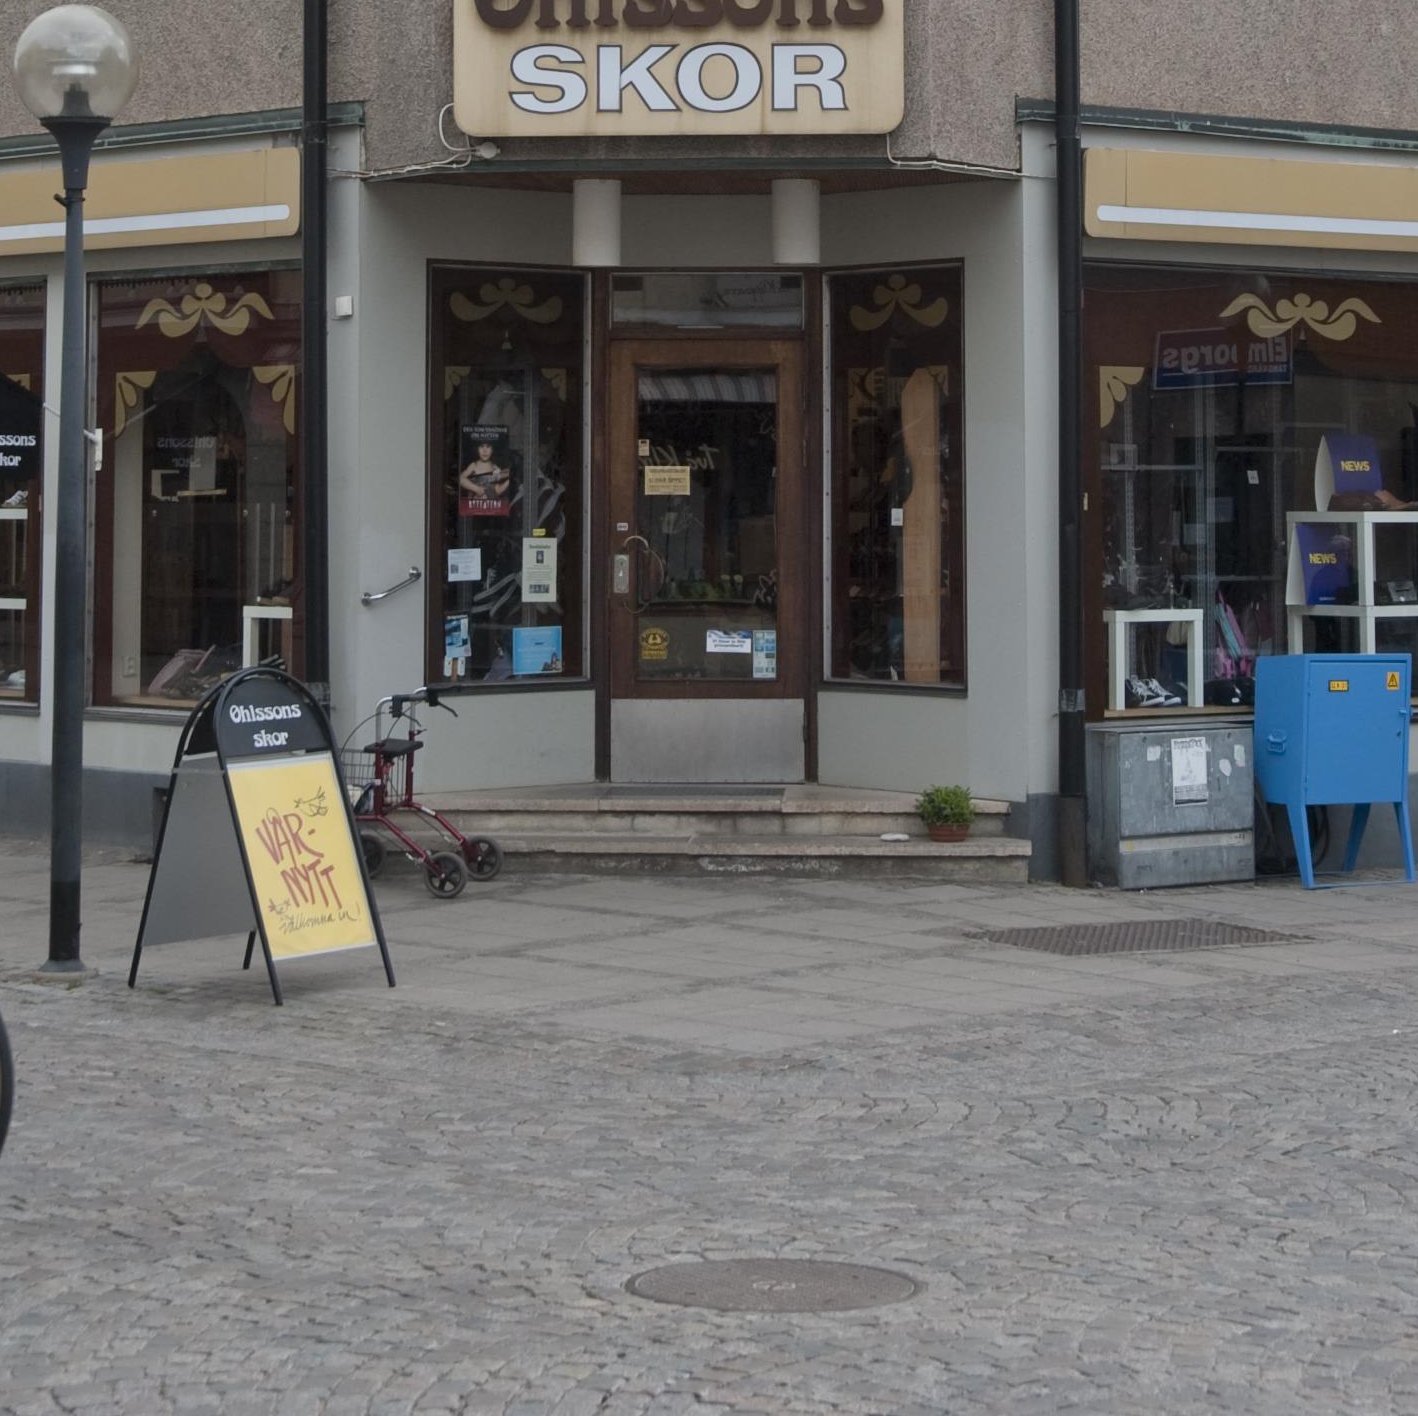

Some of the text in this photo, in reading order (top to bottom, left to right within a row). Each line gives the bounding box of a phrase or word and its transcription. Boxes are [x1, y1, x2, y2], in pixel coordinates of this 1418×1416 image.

[508, 42, 849, 115] SKOR
[1341, 460, 1370, 472] NEWS
[1309, 553, 1337, 564] NEWS
[253, 730, 289, 748] skor
[281, 859, 342, 908] NYTT
